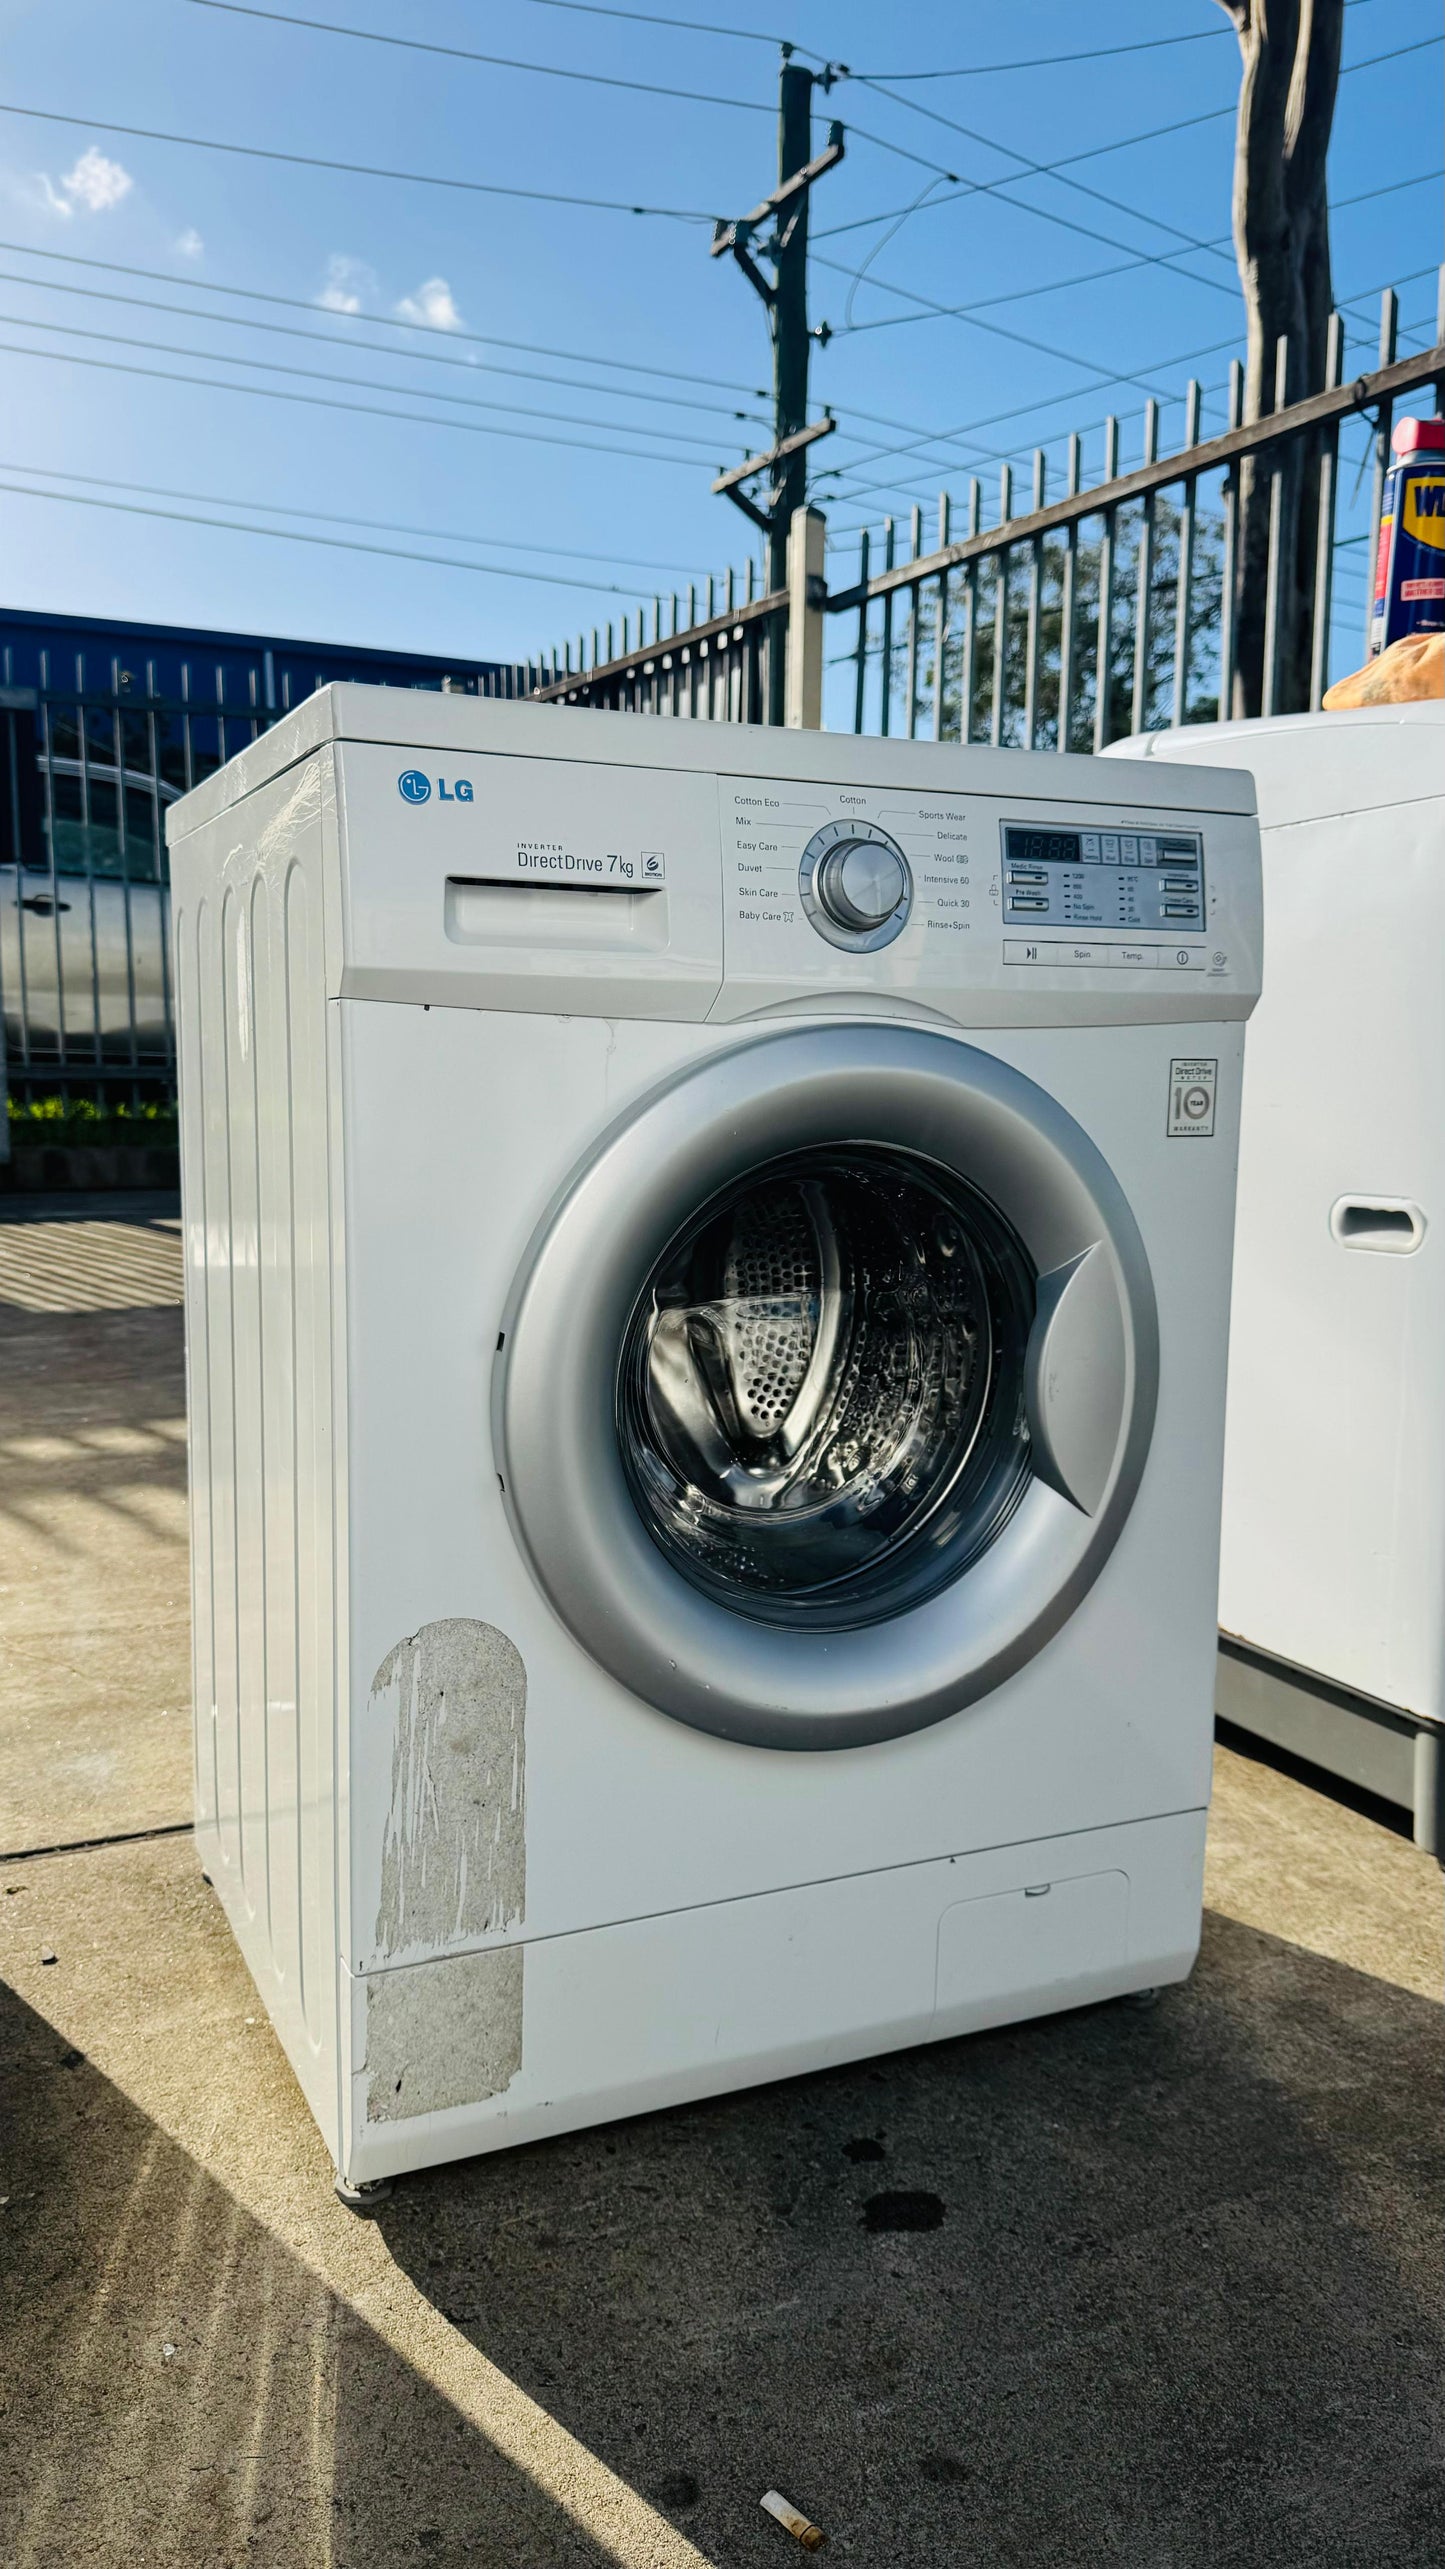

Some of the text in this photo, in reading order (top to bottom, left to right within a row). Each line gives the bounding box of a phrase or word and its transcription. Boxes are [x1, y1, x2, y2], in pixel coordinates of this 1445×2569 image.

[438, 779, 474, 802] LG
[734, 796, 780, 807] Cotton Eco
[840, 795, 866, 805] Cotton
[919, 810, 966, 821] Sports Wear
[735, 817, 752, 826] Mix
[937, 831, 968, 841] Delicate
[517, 843, 563, 851] INVERTER
[737, 841, 778, 851] Easy Care
[934, 854, 955, 863] Wool
[738, 863, 762, 872] Duvet
[924, 874, 970, 885] Intensive 60
[739, 887, 778, 898] Skin Care
[937, 898, 970, 908] Quick 30
[739, 911, 781, 921] Baby Care
[1074, 949, 1091, 959] Spin
[1175, 1067, 1195, 1075] Direct
[1174, 1086, 1210, 1120] 10
